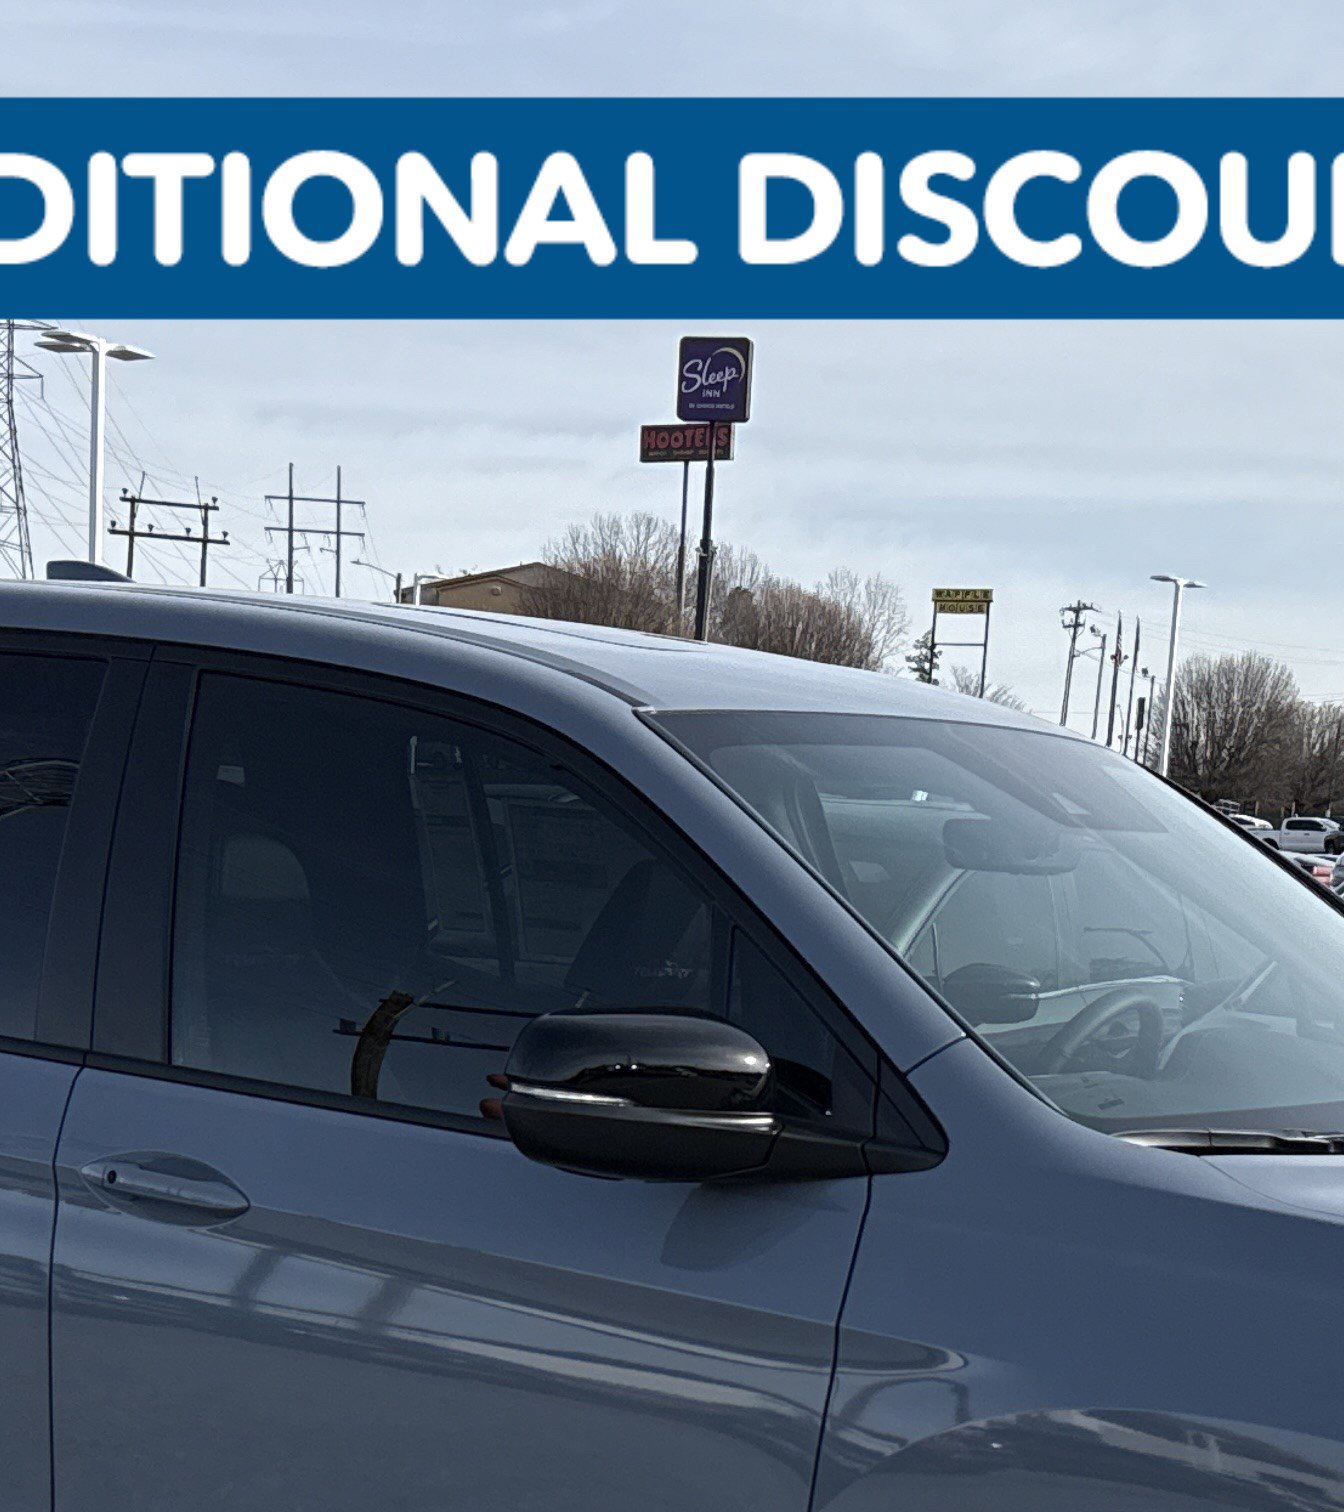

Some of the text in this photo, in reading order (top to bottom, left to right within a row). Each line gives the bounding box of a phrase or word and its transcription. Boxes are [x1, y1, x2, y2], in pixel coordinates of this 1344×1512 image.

[681, 357, 740, 393] Sleep
[702, 389, 721, 398] INN
[935, 590, 990, 599] WAFFLE
[938, 603, 985, 613] HOUSE
